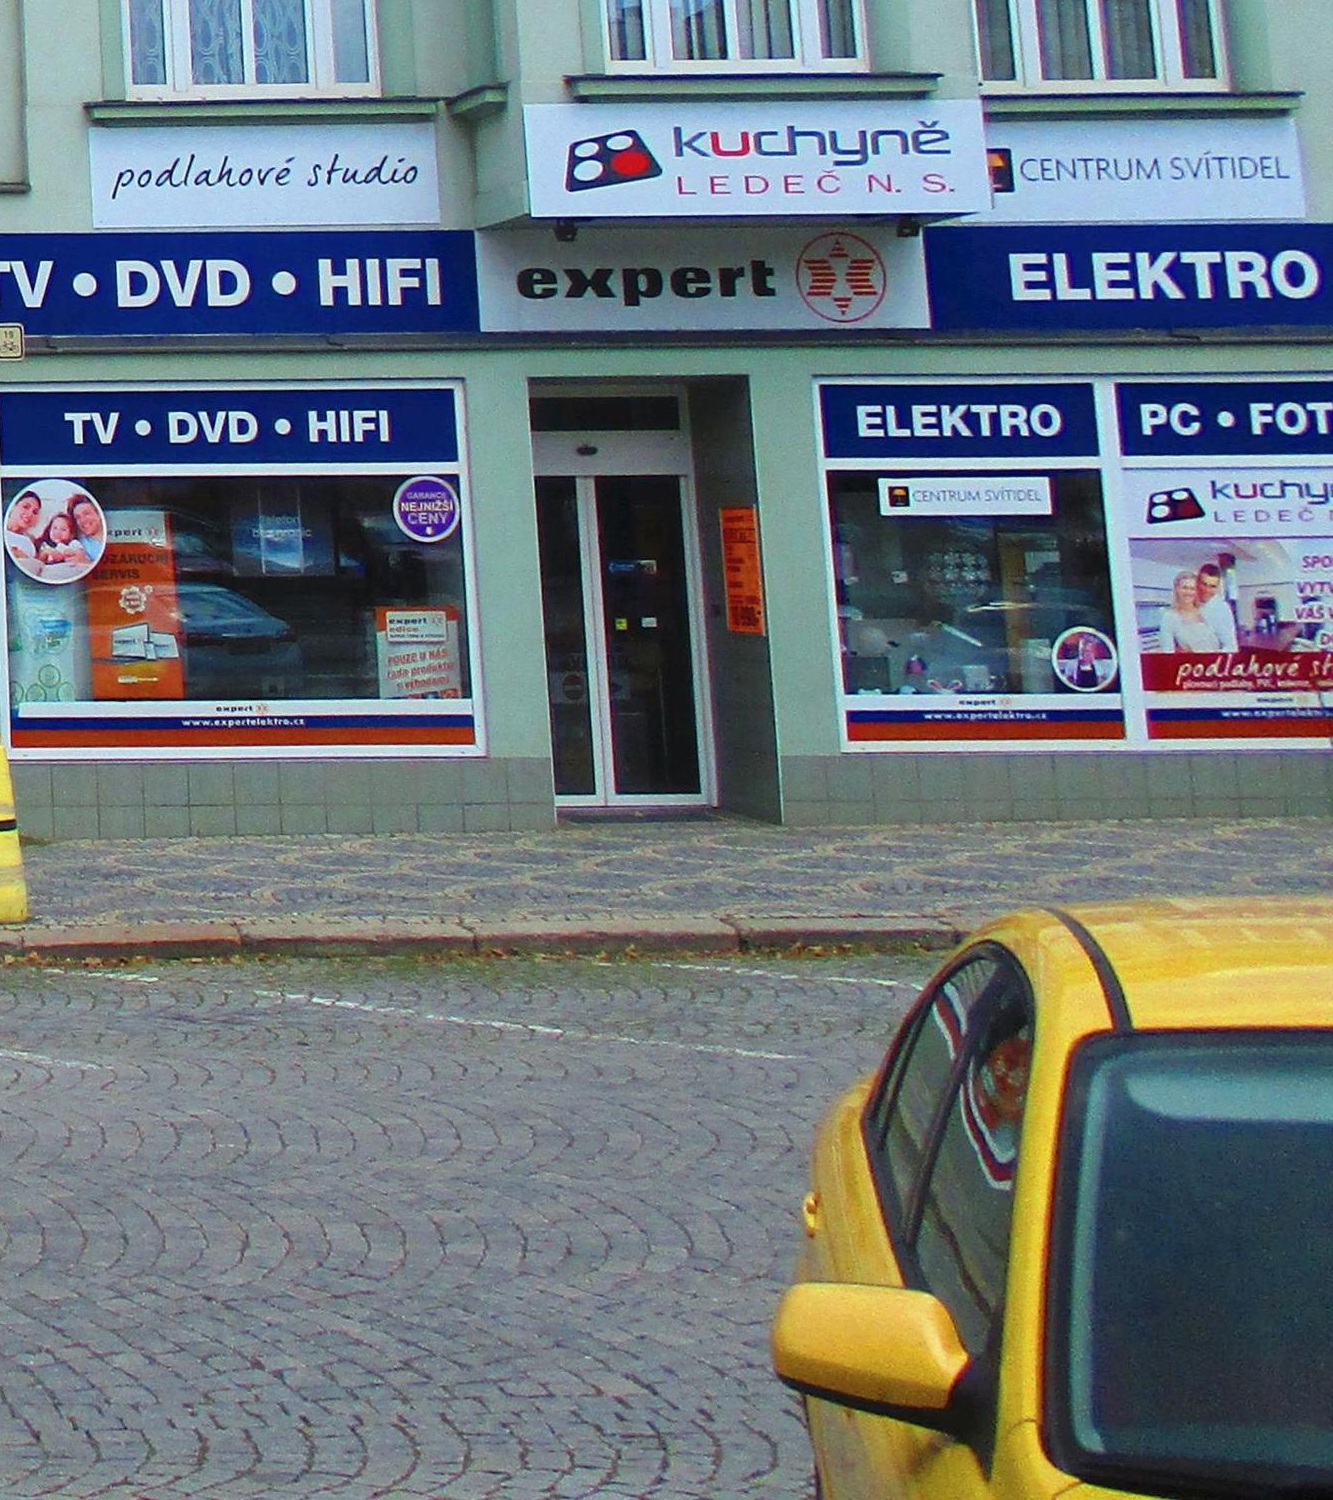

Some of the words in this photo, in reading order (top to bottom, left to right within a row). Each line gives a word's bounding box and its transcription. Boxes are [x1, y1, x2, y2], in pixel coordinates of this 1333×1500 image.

[673, 121, 951, 166] kuchyně
[112, 155, 291, 199] podlahové
[307, 153, 418, 187] studio
[1020, 158, 1161, 182] CENTRUM
[1170, 151, 1290, 181] SVÍTIDEL
[677, 169, 841, 195] LEDEČ
[868, 174, 901, 193] N.
[922, 173, 955, 193] S.
[116, 259, 251, 307] DVD
[318, 258, 441, 306] HIFI
[516, 260, 777, 306] expert
[1009, 250, 1319, 301] ELEKTRO
[65, 412, 119, 445] TV
[168, 411, 258, 444] DVD
[308, 410, 389, 443] HIFI
[856, 404, 1062, 438] ELEKTRO
[1140, 403, 1202, 437] PC
[406, 491, 447, 500] GARANCE
[912, 490, 980, 503] CENTRUM
[984, 486, 1042, 502] SVÍTIDEL
[1210, 480, 1333, 505] kuchy
[407, 512, 449, 525] CENY
[1214, 507, 1315, 523] LEDEČ
[106, 528, 142, 537] xpert
[389, 617, 427, 626] expert
[1175, 653, 1301, 685] podlahové
[182, 717, 305, 727] www.expertelektro.cz
[215, 704, 253, 712] expert
